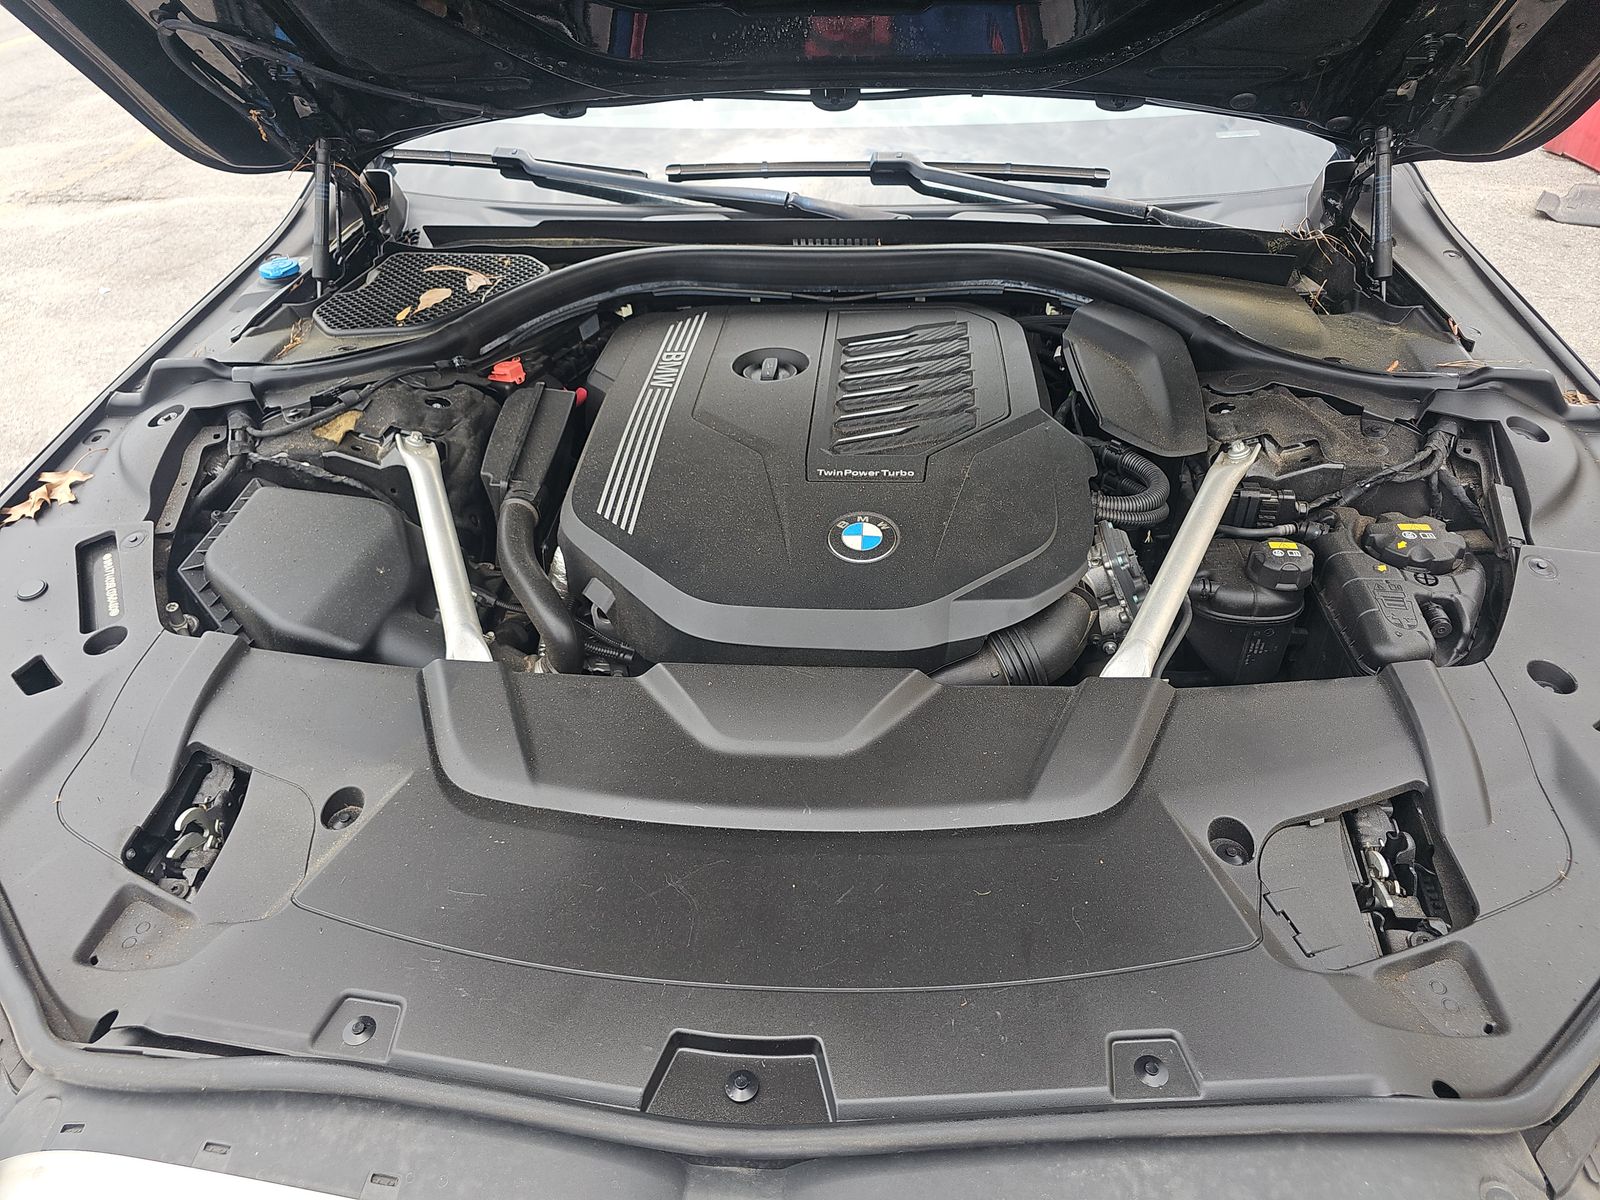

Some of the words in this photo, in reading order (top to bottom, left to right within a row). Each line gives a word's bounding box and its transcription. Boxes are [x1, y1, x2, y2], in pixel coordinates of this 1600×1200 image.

[650, 352, 686, 388] BMW
[881, 469, 915, 477] Turbo
[836, 516, 890, 530] BMW
